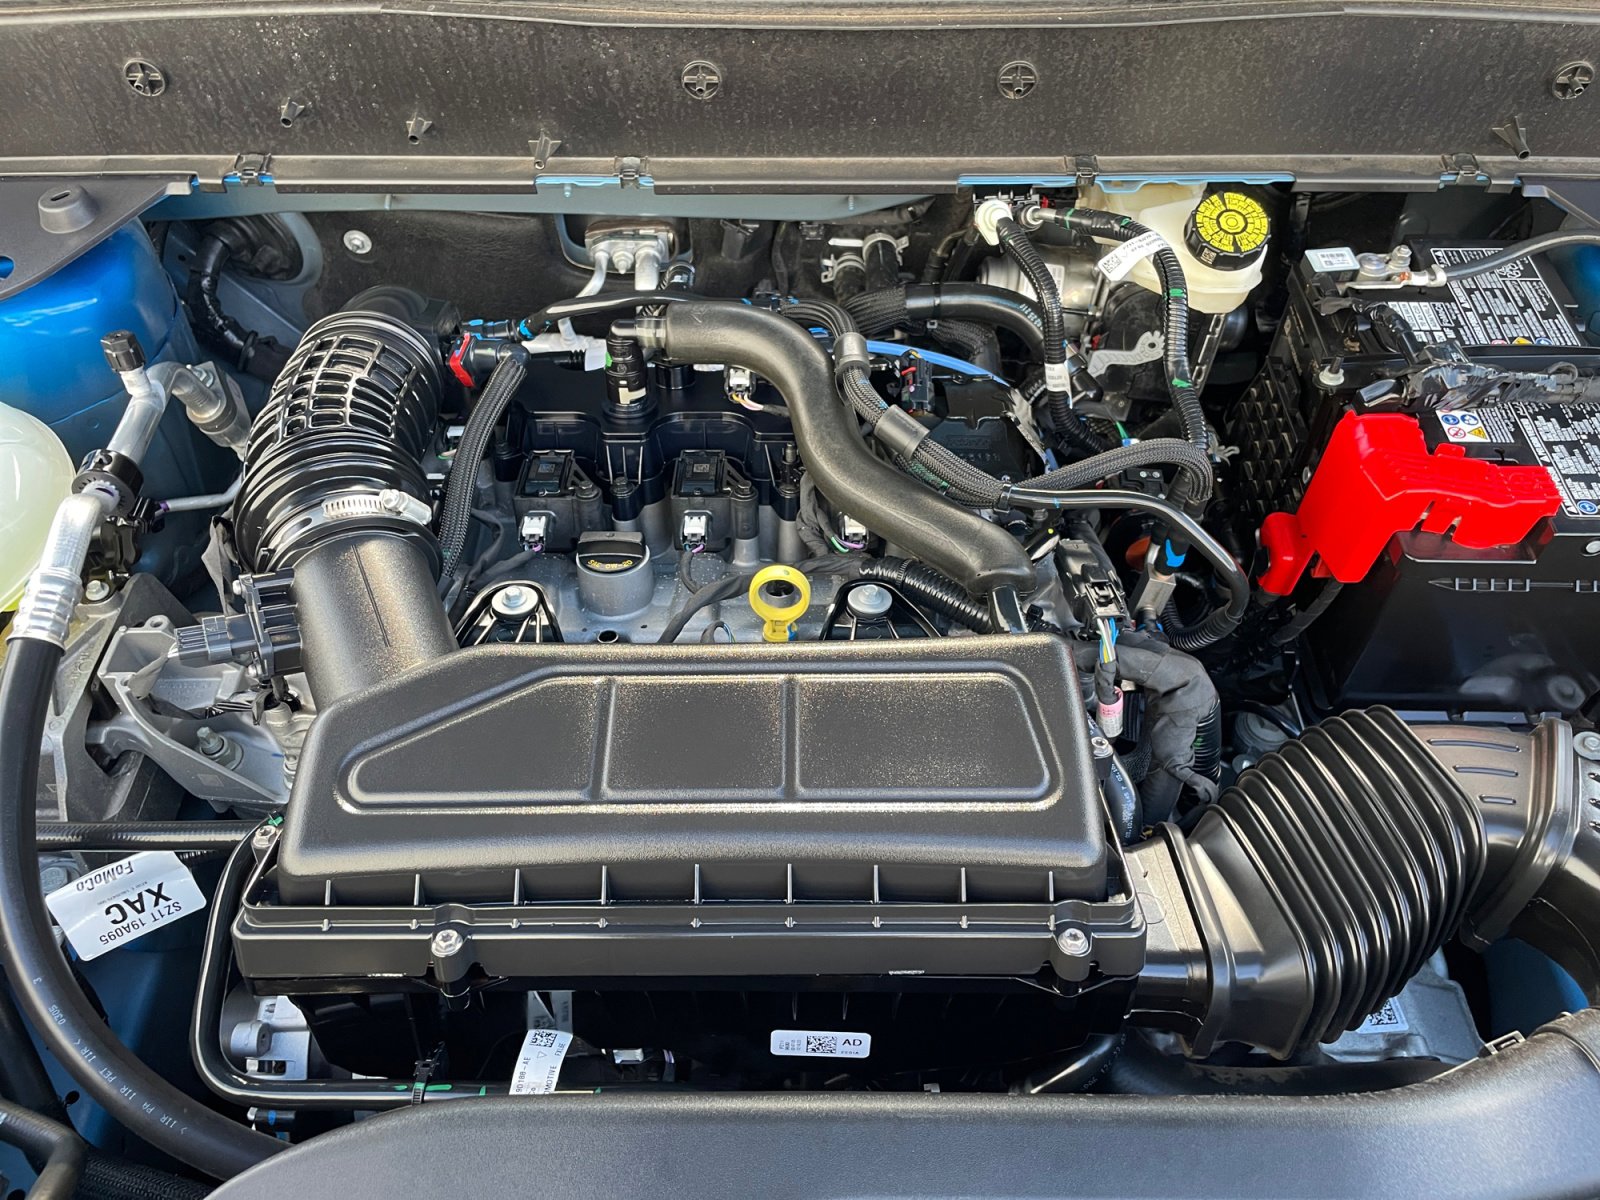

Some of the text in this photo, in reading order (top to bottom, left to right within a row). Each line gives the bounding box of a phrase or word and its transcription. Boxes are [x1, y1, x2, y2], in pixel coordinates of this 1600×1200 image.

[76, 860, 135, 892] FoMoCo
[104, 881, 173, 925] XAC
[99, 901, 182, 946] SZ1T 19A095
[842, 1038, 862, 1047] AD
[99, 1067, 117, 1083] PET
